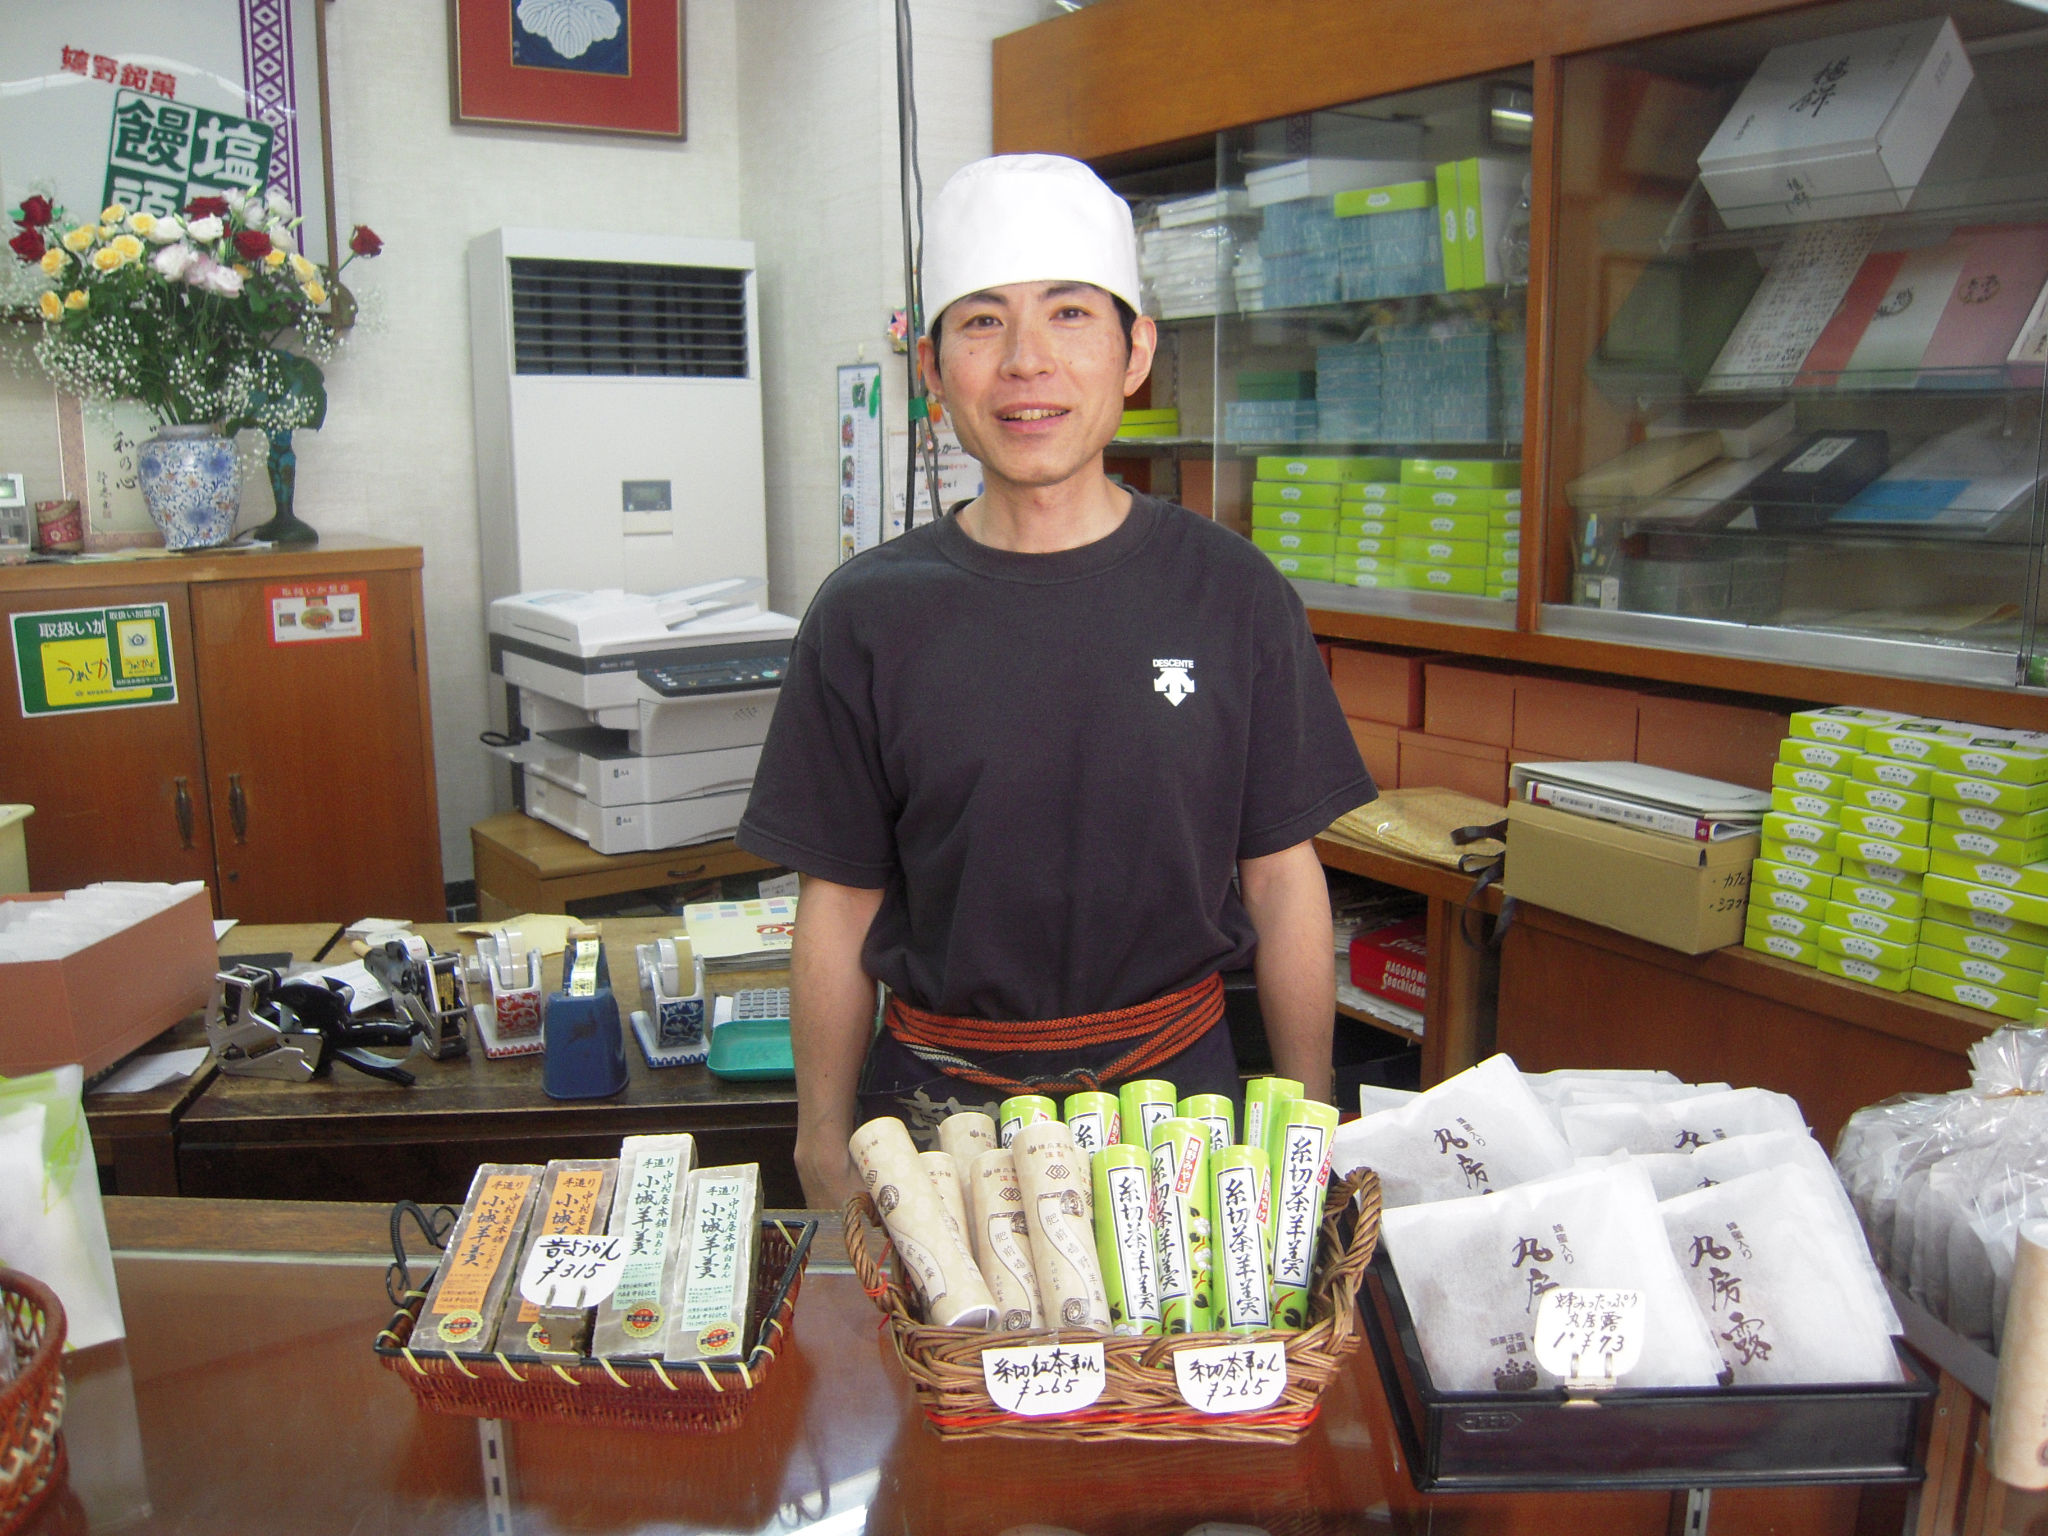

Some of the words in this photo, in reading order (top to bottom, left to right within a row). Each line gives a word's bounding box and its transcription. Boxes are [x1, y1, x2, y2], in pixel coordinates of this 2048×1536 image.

[61, 45, 177, 100] 嬉野銘菓
[109, 607, 161, 620] 取扱い加盟店
[1152, 658, 1195, 668] DESCENTE
[642, 1156, 675, 1169] 手造り
[1175, 1138, 1201, 1193] 嬉野みやげ
[1433, 1127, 1494, 1195] 丸房
[492, 1180, 524, 1191] 手造り
[563, 1177, 596, 1189] 手造り
[705, 1184, 740, 1197] 手造り
[630, 1175, 661, 1256] 小城羊羹
[1153, 1157, 1180, 1292] 糸切茶羊羹
[1281, 1136, 1314, 1277] 糸切茶羊羹
[460, 1195, 506, 1267] 小城羊羹
[539, 1237, 622, 1261] 昔ようかん
[694, 1202, 726, 1280] 小城羊羹
[1119, 1176, 1155, 1311] 糸切茶羊羹
[1225, 1178, 1260, 1317] 糸切茶羊羹
[536, 1258, 607, 1286] ¥315
[1015, 1378, 1080, 1409] ¥265
[1207, 1378, 1270, 1407] ¥265
